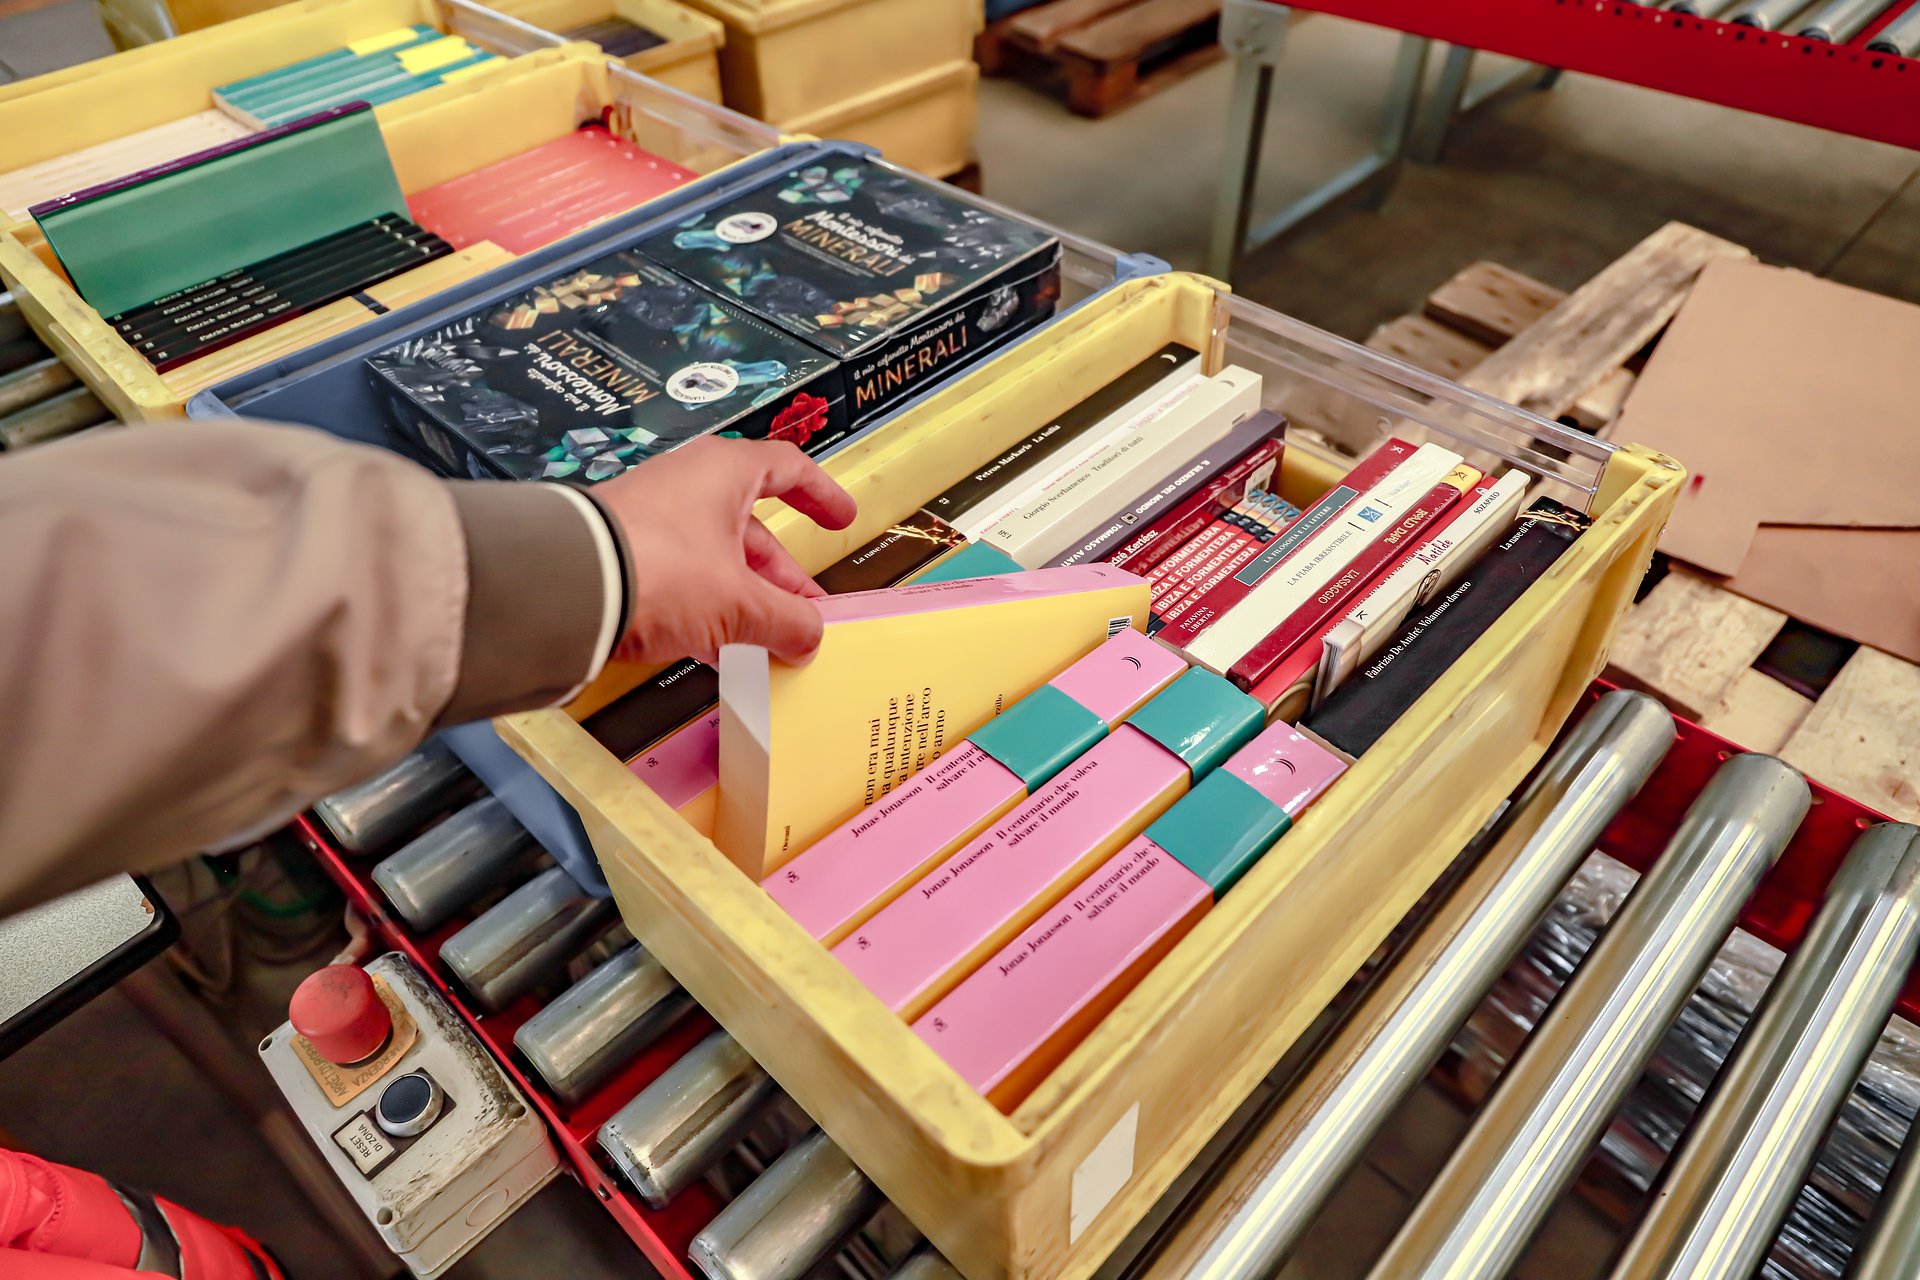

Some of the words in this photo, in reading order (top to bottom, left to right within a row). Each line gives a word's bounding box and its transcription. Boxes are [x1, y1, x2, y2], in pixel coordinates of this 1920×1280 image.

[782, 219, 906, 276] MINERALI
[805, 210, 902, 258] Montessori
[537, 329, 660, 404] MINERALI
[856, 325, 967, 409] MINERALI
[862, 364, 875, 376] mio
[877, 345, 909, 367] cofanetto
[910, 320, 954, 349] Montessori
[533, 352, 631, 416] Montessori
[975, 463, 1001, 482] Petros
[998, 443, 1032, 467] Markaris
[1032, 436, 1043, 445] La
[1023, 499, 1050, 520] Giorgio
[1048, 474, 1091, 503] Scerbanenco
[1092, 450, 1122, 473] Traditori
[1121, 444, 1130, 454] di
[1128, 436, 1144, 449] tutti
[1175, 463, 1204, 487] SILENZIO
[1203, 459, 1211, 467] IL
[1135, 493, 1164, 514] MONDO
[1161, 482, 1177, 495] DEL
[1474, 491, 1500, 514] SOZAPATO
[1084, 523, 1124, 550] TOMMASO
[1263, 555, 1275, 563] LA
[1271, 532, 1300, 557] FILOSOFIA
[1302, 523, 1311, 531] LE
[1310, 505, 1332, 525] LETTERE
[1403, 508, 1428, 529] ROALD
[853, 554, 866, 566] La
[864, 545, 882, 561] nave
[879, 538, 889, 550] di
[1125, 530, 1159, 553] Kertész
[1154, 568, 1165, 577] E
[1161, 525, 1221, 572] FORMENTERA
[1416, 539, 1453, 565] Matilde
[1500, 541, 1511, 551] La
[1509, 530, 1521, 547] nave
[1519, 525, 1526, 535] di
[1060, 549, 1085, 567] AVATI
[1151, 581, 1172, 600] BIZA
[1168, 574, 1179, 583] E
[1174, 530, 1235, 578] FORMENTERA
[1155, 590, 1184, 611] IBIZA
[1180, 583, 1190, 592] E
[1187, 537, 1247, 585] FORMENTERA
[1287, 576, 1299, 586] LA
[1297, 560, 1316, 580] FIABA
[1314, 530, 1353, 563] IRRESISTIBILE
[1166, 599, 1193, 621] IBIZA
[1190, 592, 1201, 600] E
[1198, 546, 1258, 596] FORMENTERA
[1318, 569, 1361, 605] L'ASSAGGIO
[1180, 606, 1209, 630] PATAVINA
[1188, 610, 1215, 633] LIBERTAS
[1365, 652, 1395, 679] Fabrizio
[1392, 640, 1404, 653] De
[1418, 600, 1450, 627] Volammo
[1447, 581, 1472, 603] davvero
[658, 664, 696, 688] Fabrizio
[868, 717, 881, 747] mai
[898, 693, 915, 770] intenzione
[916, 687, 932, 748] nell'arco
[933, 709, 946, 747] anno
[883, 697, 900, 780] qualunque
[867, 751, 879, 775] era
[936, 767, 968, 792] salvare
[968, 760, 977, 769] il
[851, 815, 880, 838] Jonas
[879, 785, 923, 818] Jonasson
[925, 774, 936, 784] Il
[936, 745, 980, 777] centenari
[864, 779, 876, 807] non
[922, 875, 951, 899] Jonas
[950, 841, 994, 877] Jonasson
[995, 829, 1007, 840] Il
[1006, 794, 1054, 833] centenario
[1053, 780, 1072, 796] che
[1070, 760, 1098, 783] voleva
[1007, 820, 1040, 848] salvare
[1039, 812, 1049, 822] il
[1048, 789, 1080, 815] mondo
[1087, 892, 1120, 920] salvare
[1119, 883, 1129, 893] il
[1128, 857, 1160, 886] mondo
[998, 951, 1028, 976] Jonas
[1027, 914, 1072, 952] Jonasson
[1073, 901, 1086, 911] Il
[1085, 862, 1134, 903] centenario
[1132, 848, 1149, 863] che
[351, 1041, 404, 1087] EMERGENZA
[324, 1073, 349, 1096] ARRÊT
[349, 1135, 372, 1158] RESET
[358, 1124, 377, 1144] ZONA
[373, 1142, 383, 1152] DI
